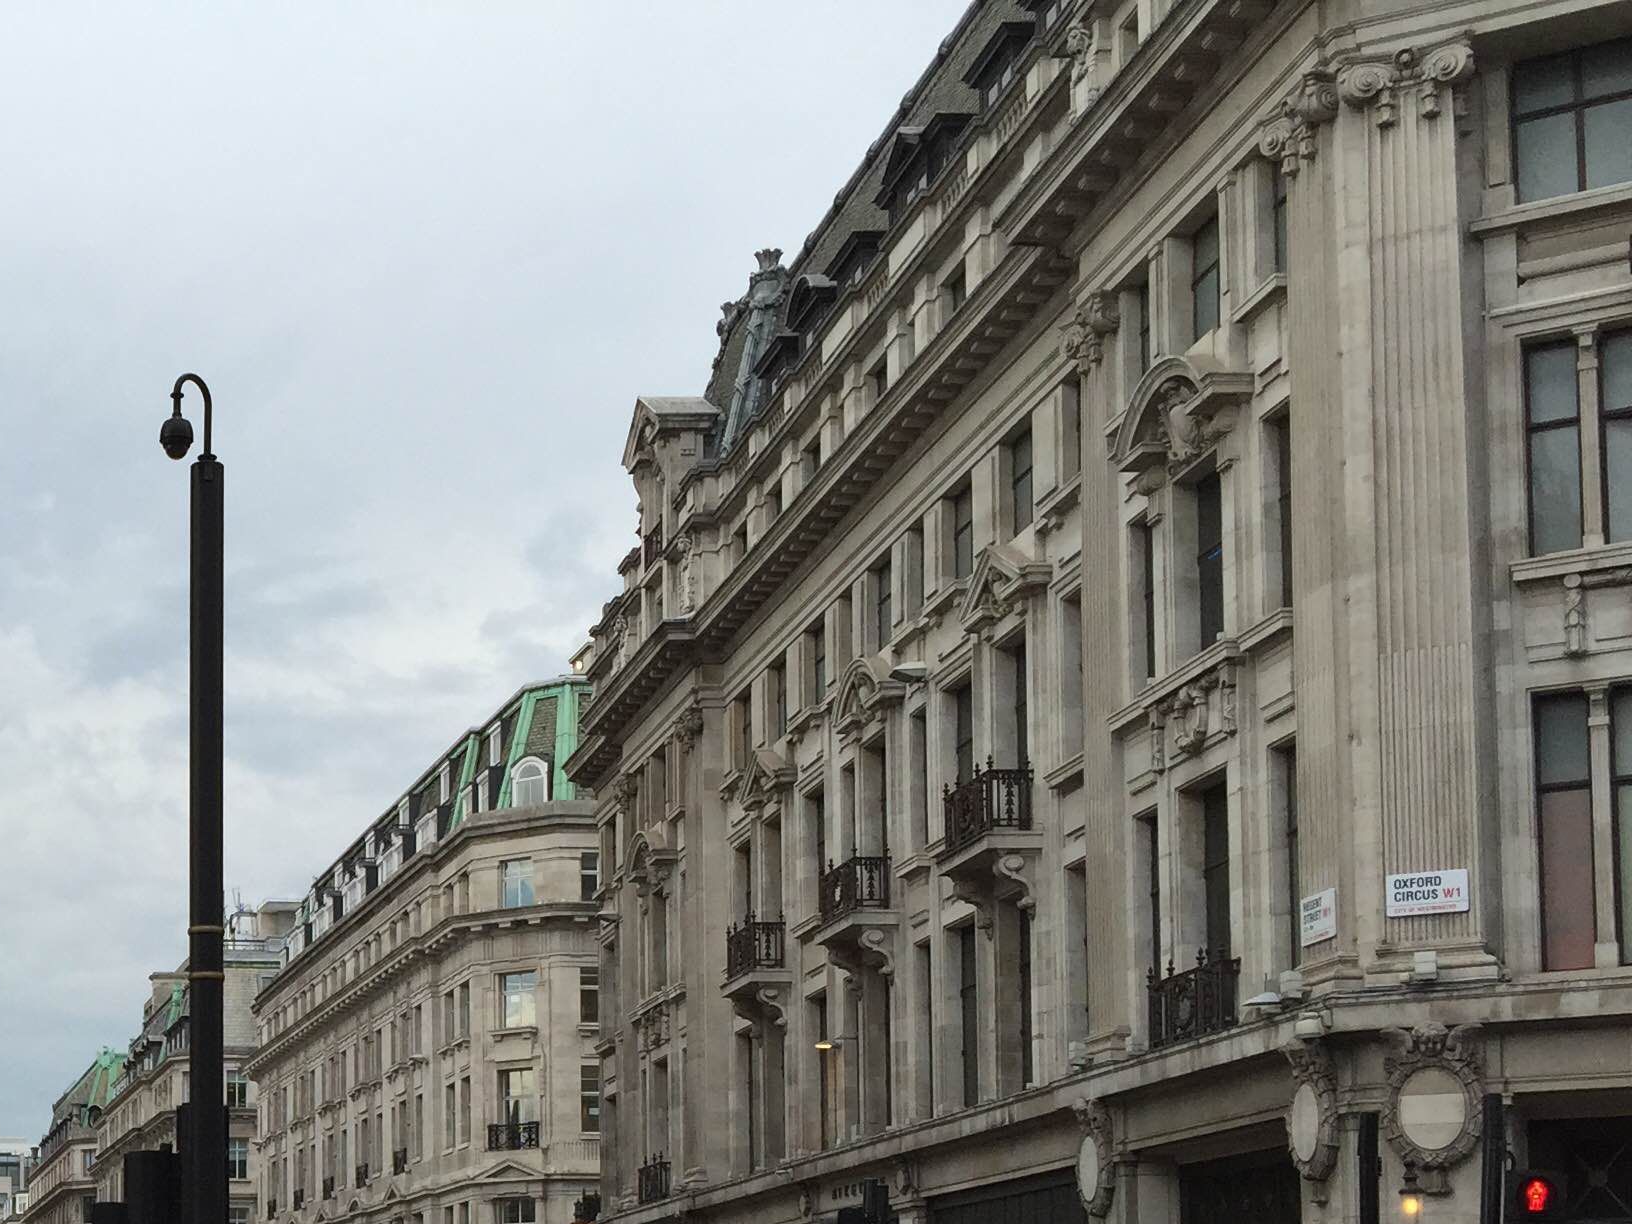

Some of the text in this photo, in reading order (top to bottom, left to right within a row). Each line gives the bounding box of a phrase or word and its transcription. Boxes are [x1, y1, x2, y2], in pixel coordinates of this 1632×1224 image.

[1393, 876, 1442, 890] OXFORD
[1394, 887, 1461, 902] CIRCUS W1
